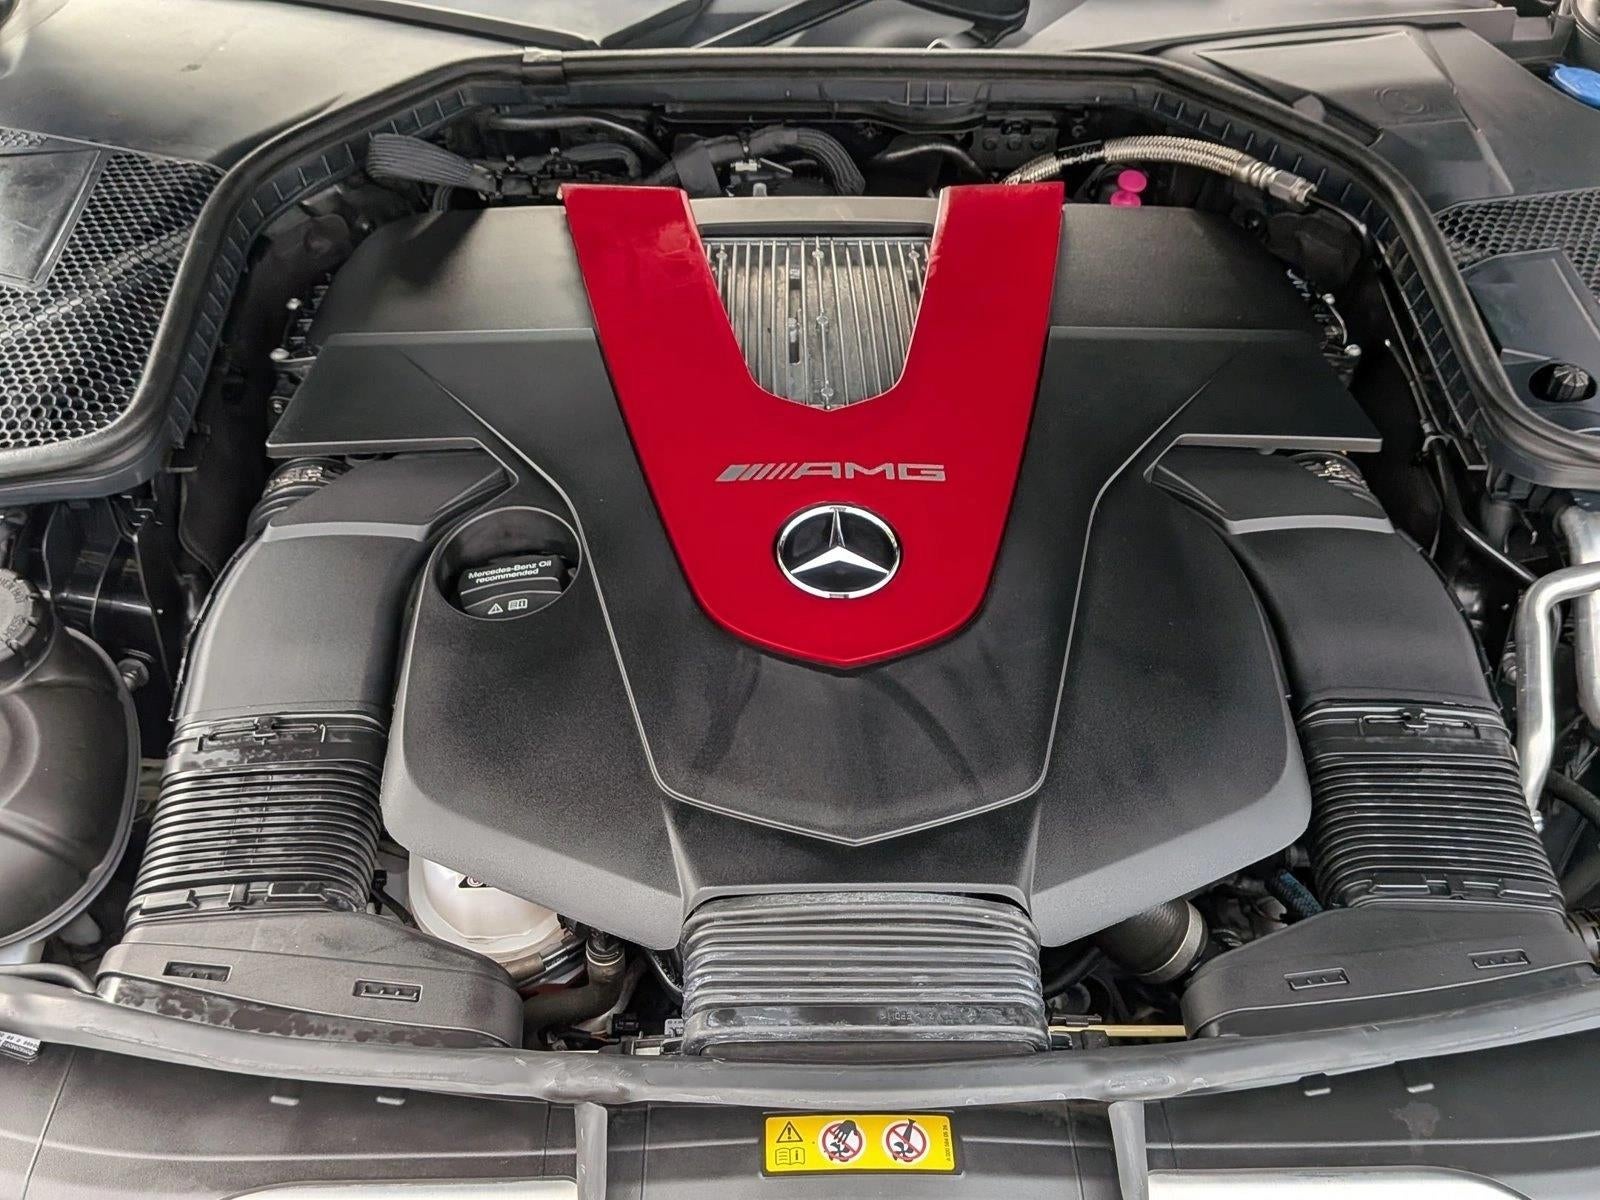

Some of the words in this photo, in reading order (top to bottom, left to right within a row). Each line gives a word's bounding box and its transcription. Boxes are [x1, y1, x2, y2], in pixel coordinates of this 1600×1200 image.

[790, 462, 946, 481] AMG
[468, 563, 537, 579] Mercedes-Benz
[538, 560, 552, 568] Oil
[476, 568, 539, 584] recommended
